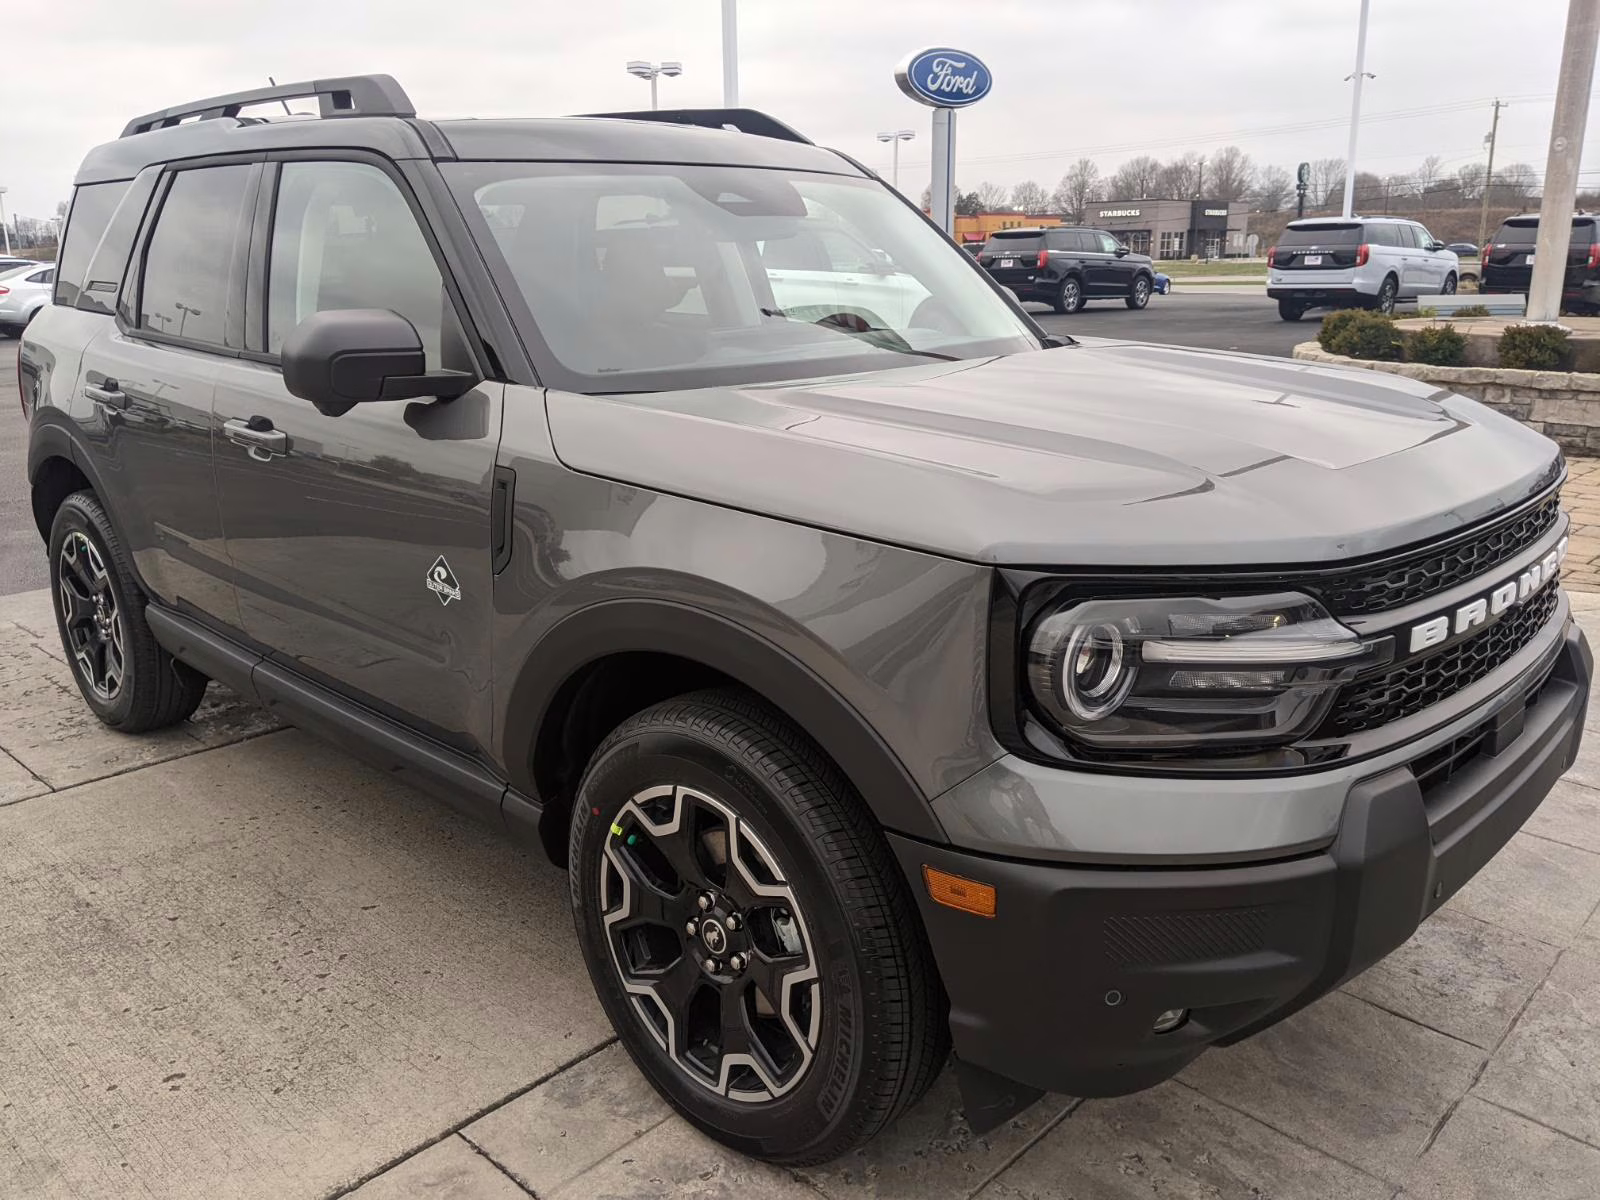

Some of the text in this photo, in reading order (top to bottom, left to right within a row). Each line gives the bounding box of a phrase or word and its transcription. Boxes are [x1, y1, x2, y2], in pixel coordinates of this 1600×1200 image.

[927, 57, 978, 95] Ford
[1099, 209, 1140, 218] STARBUCKS
[821, 1003, 852, 1114] MICHELIN
